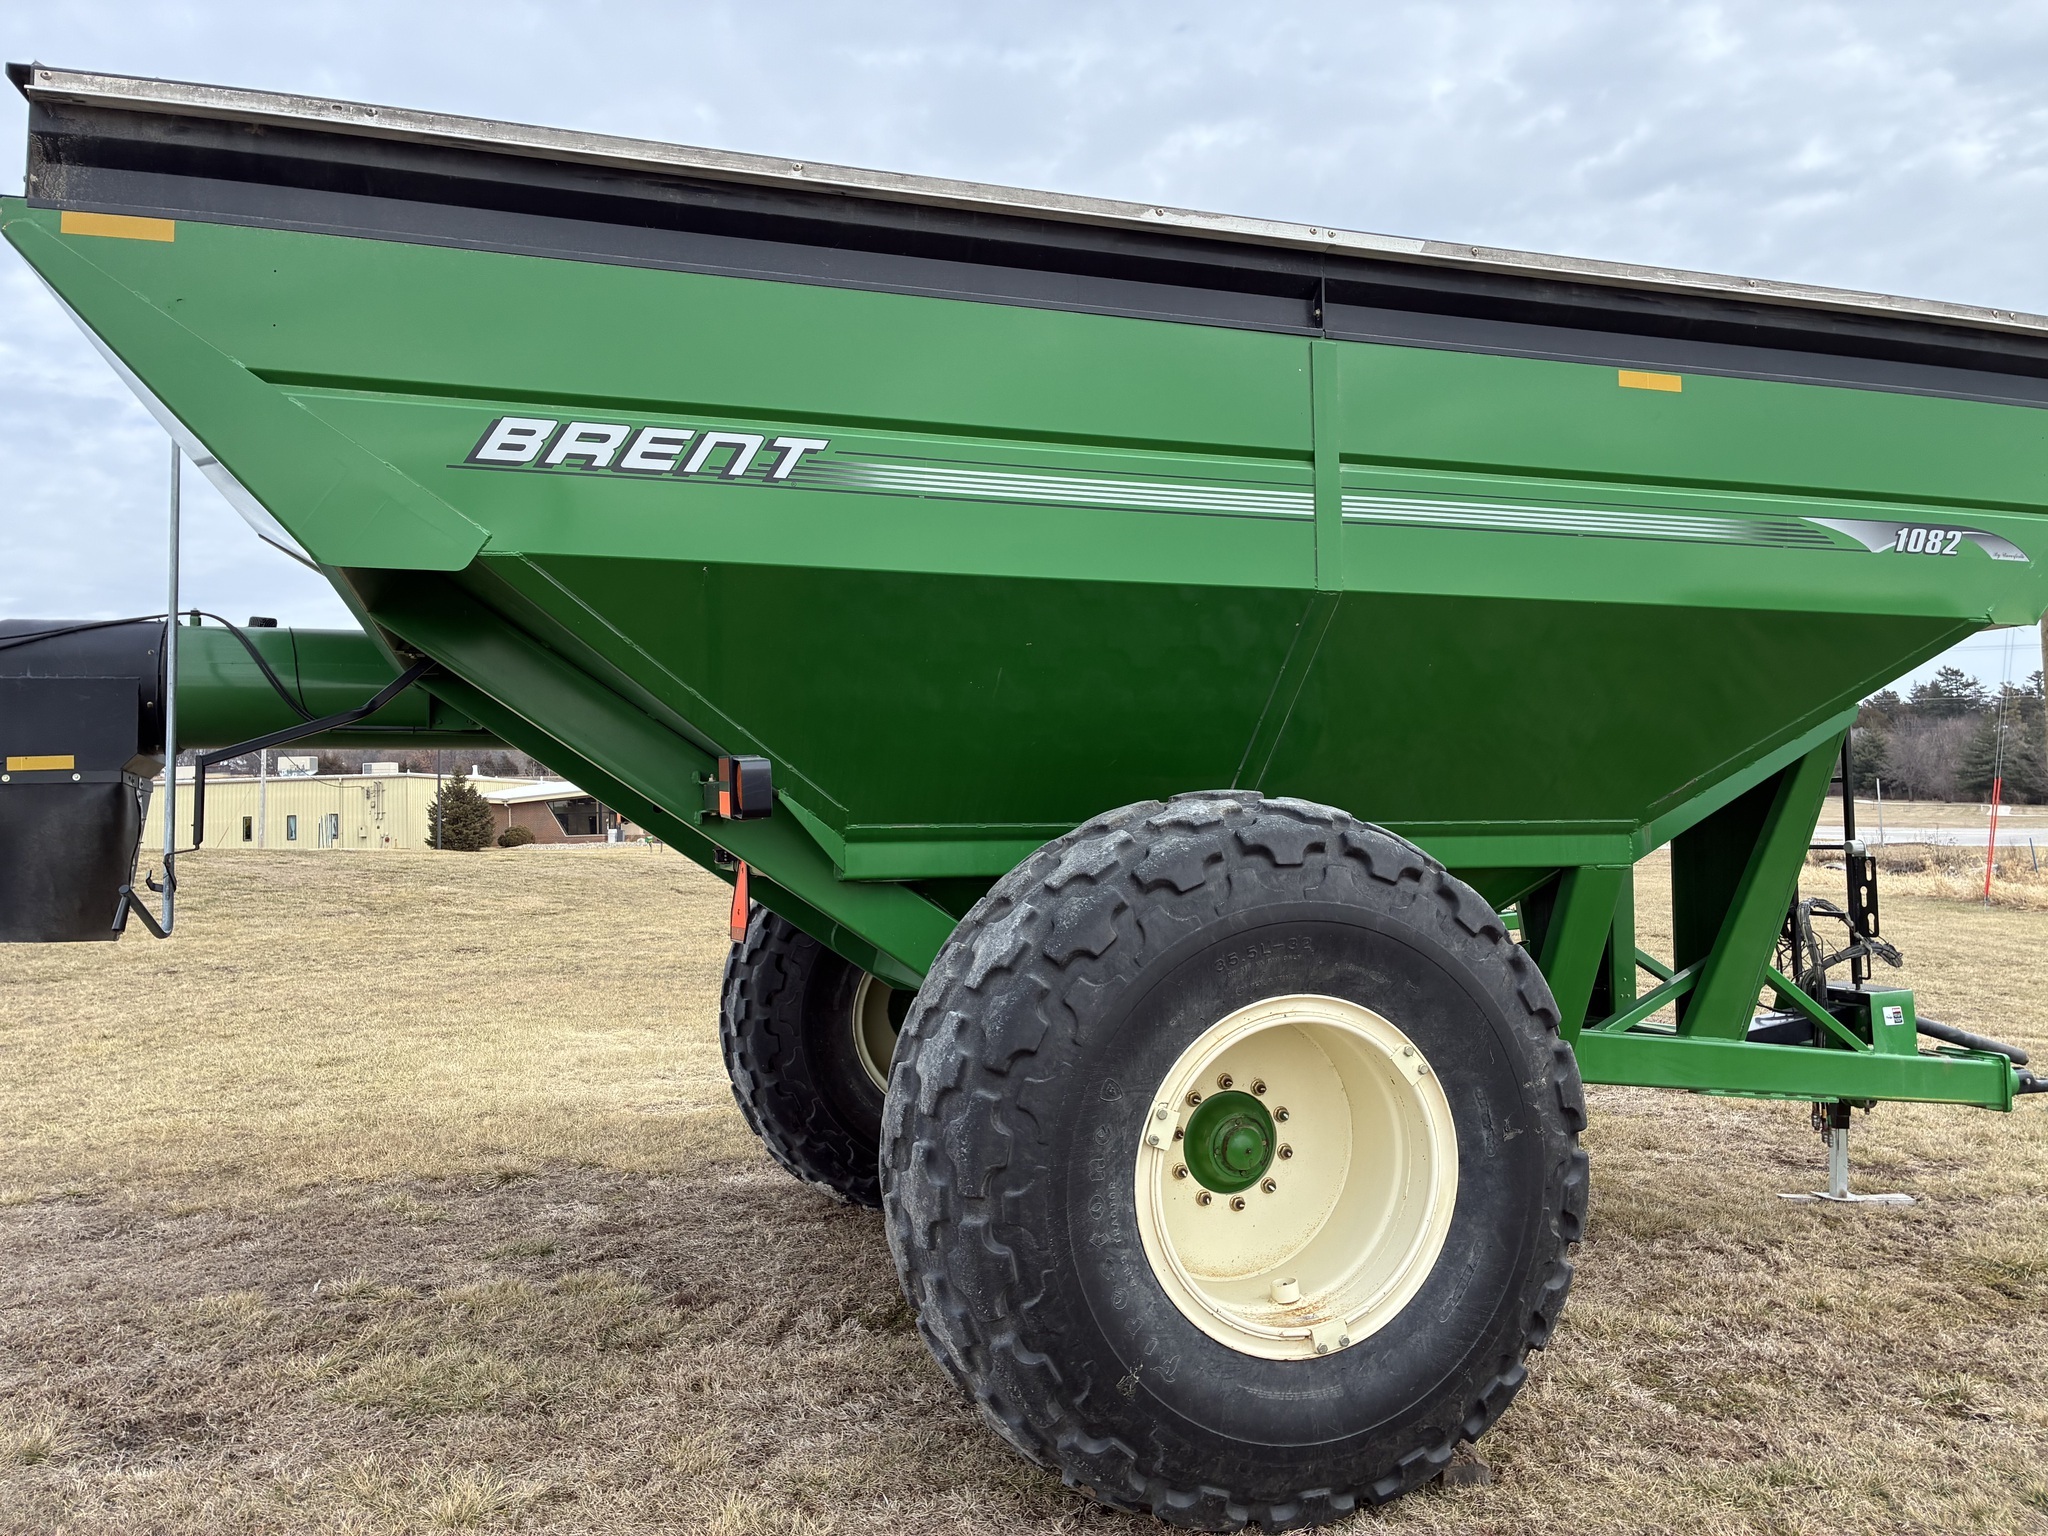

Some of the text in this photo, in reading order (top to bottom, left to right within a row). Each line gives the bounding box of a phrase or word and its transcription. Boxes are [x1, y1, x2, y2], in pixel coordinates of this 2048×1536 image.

[466, 416, 830, 482] BRENT
[1896, 527, 1962, 555] 1082
[1214, 936, 1313, 973] 35.5L-32
